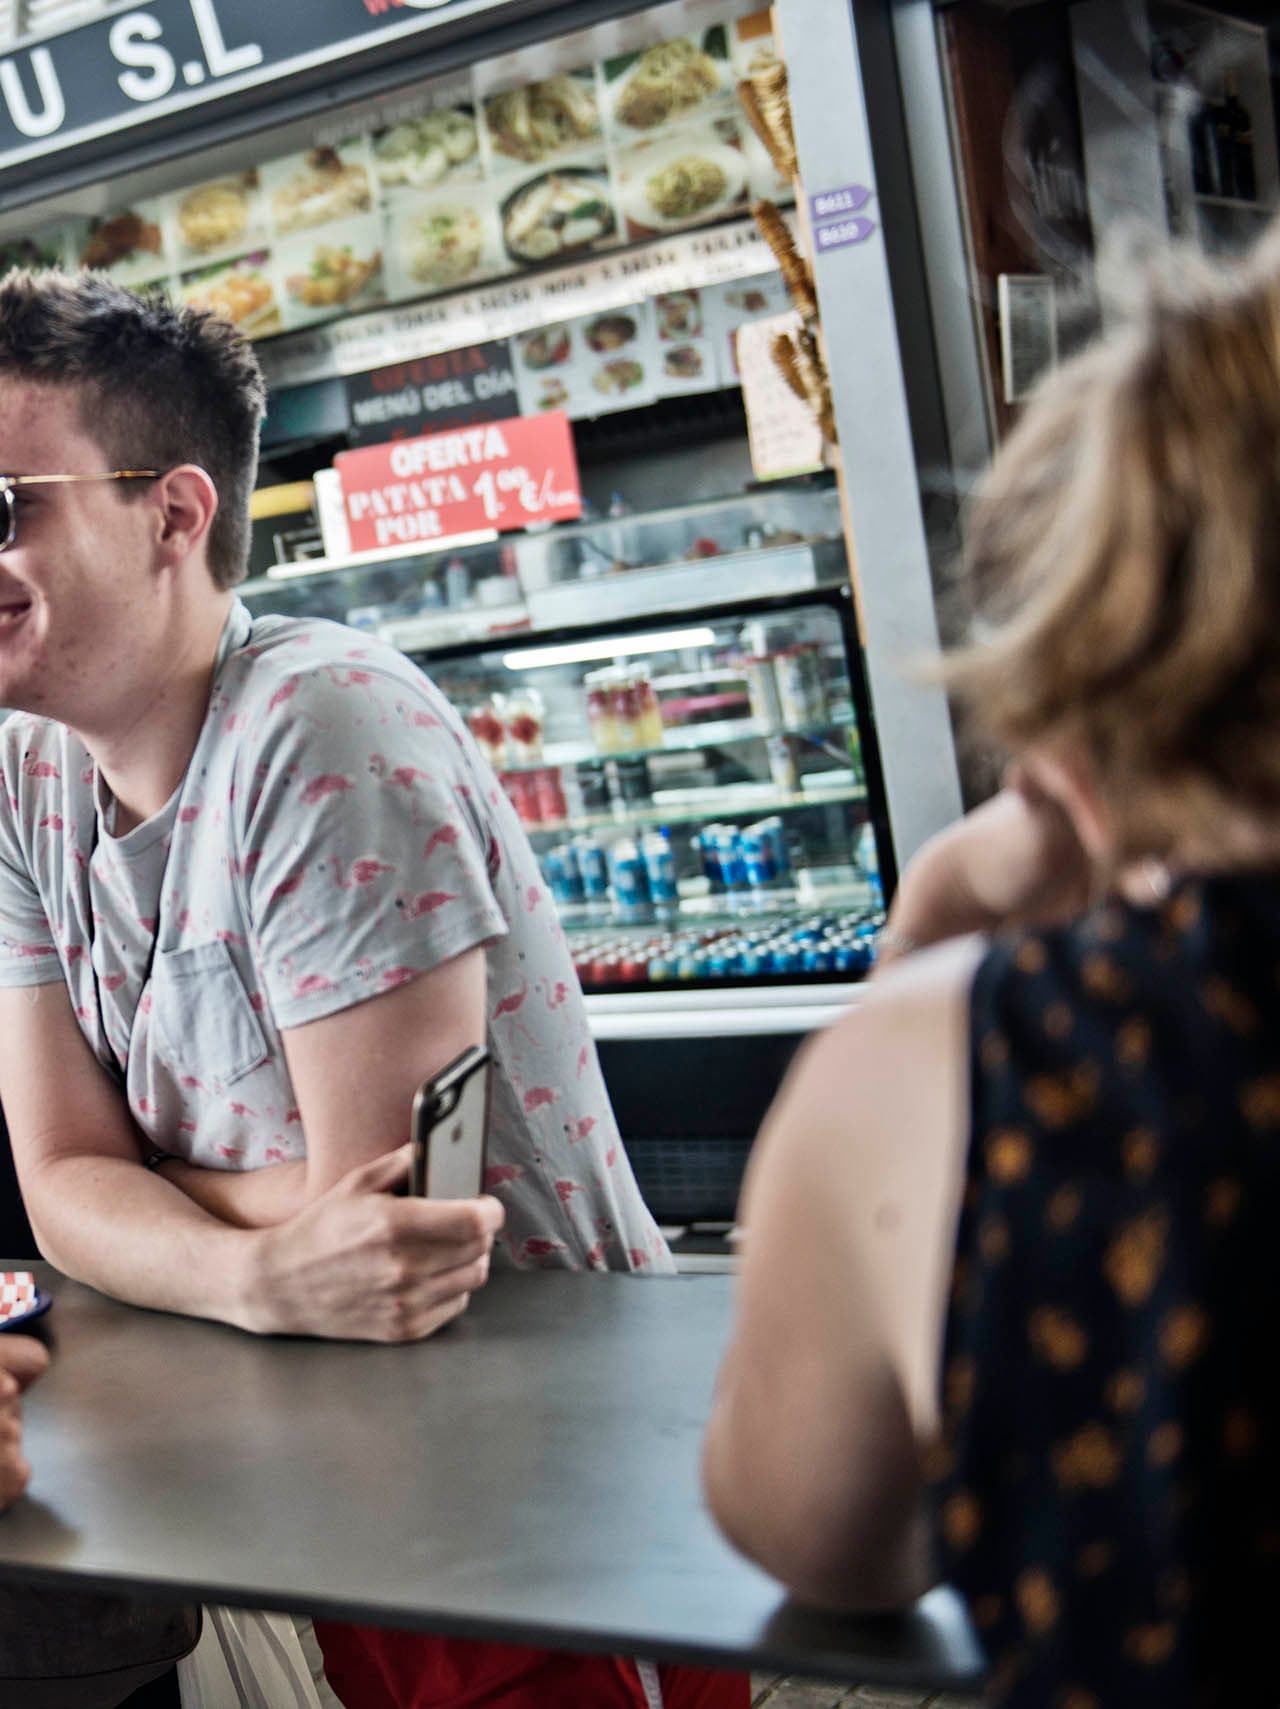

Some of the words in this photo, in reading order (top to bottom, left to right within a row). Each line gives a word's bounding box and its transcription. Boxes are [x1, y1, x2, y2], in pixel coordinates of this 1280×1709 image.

[422, 379, 473, 411] DEL
[389, 426, 509, 478] OFERTA
[347, 473, 468, 521] PATATA
[375, 508, 442, 546] POR
